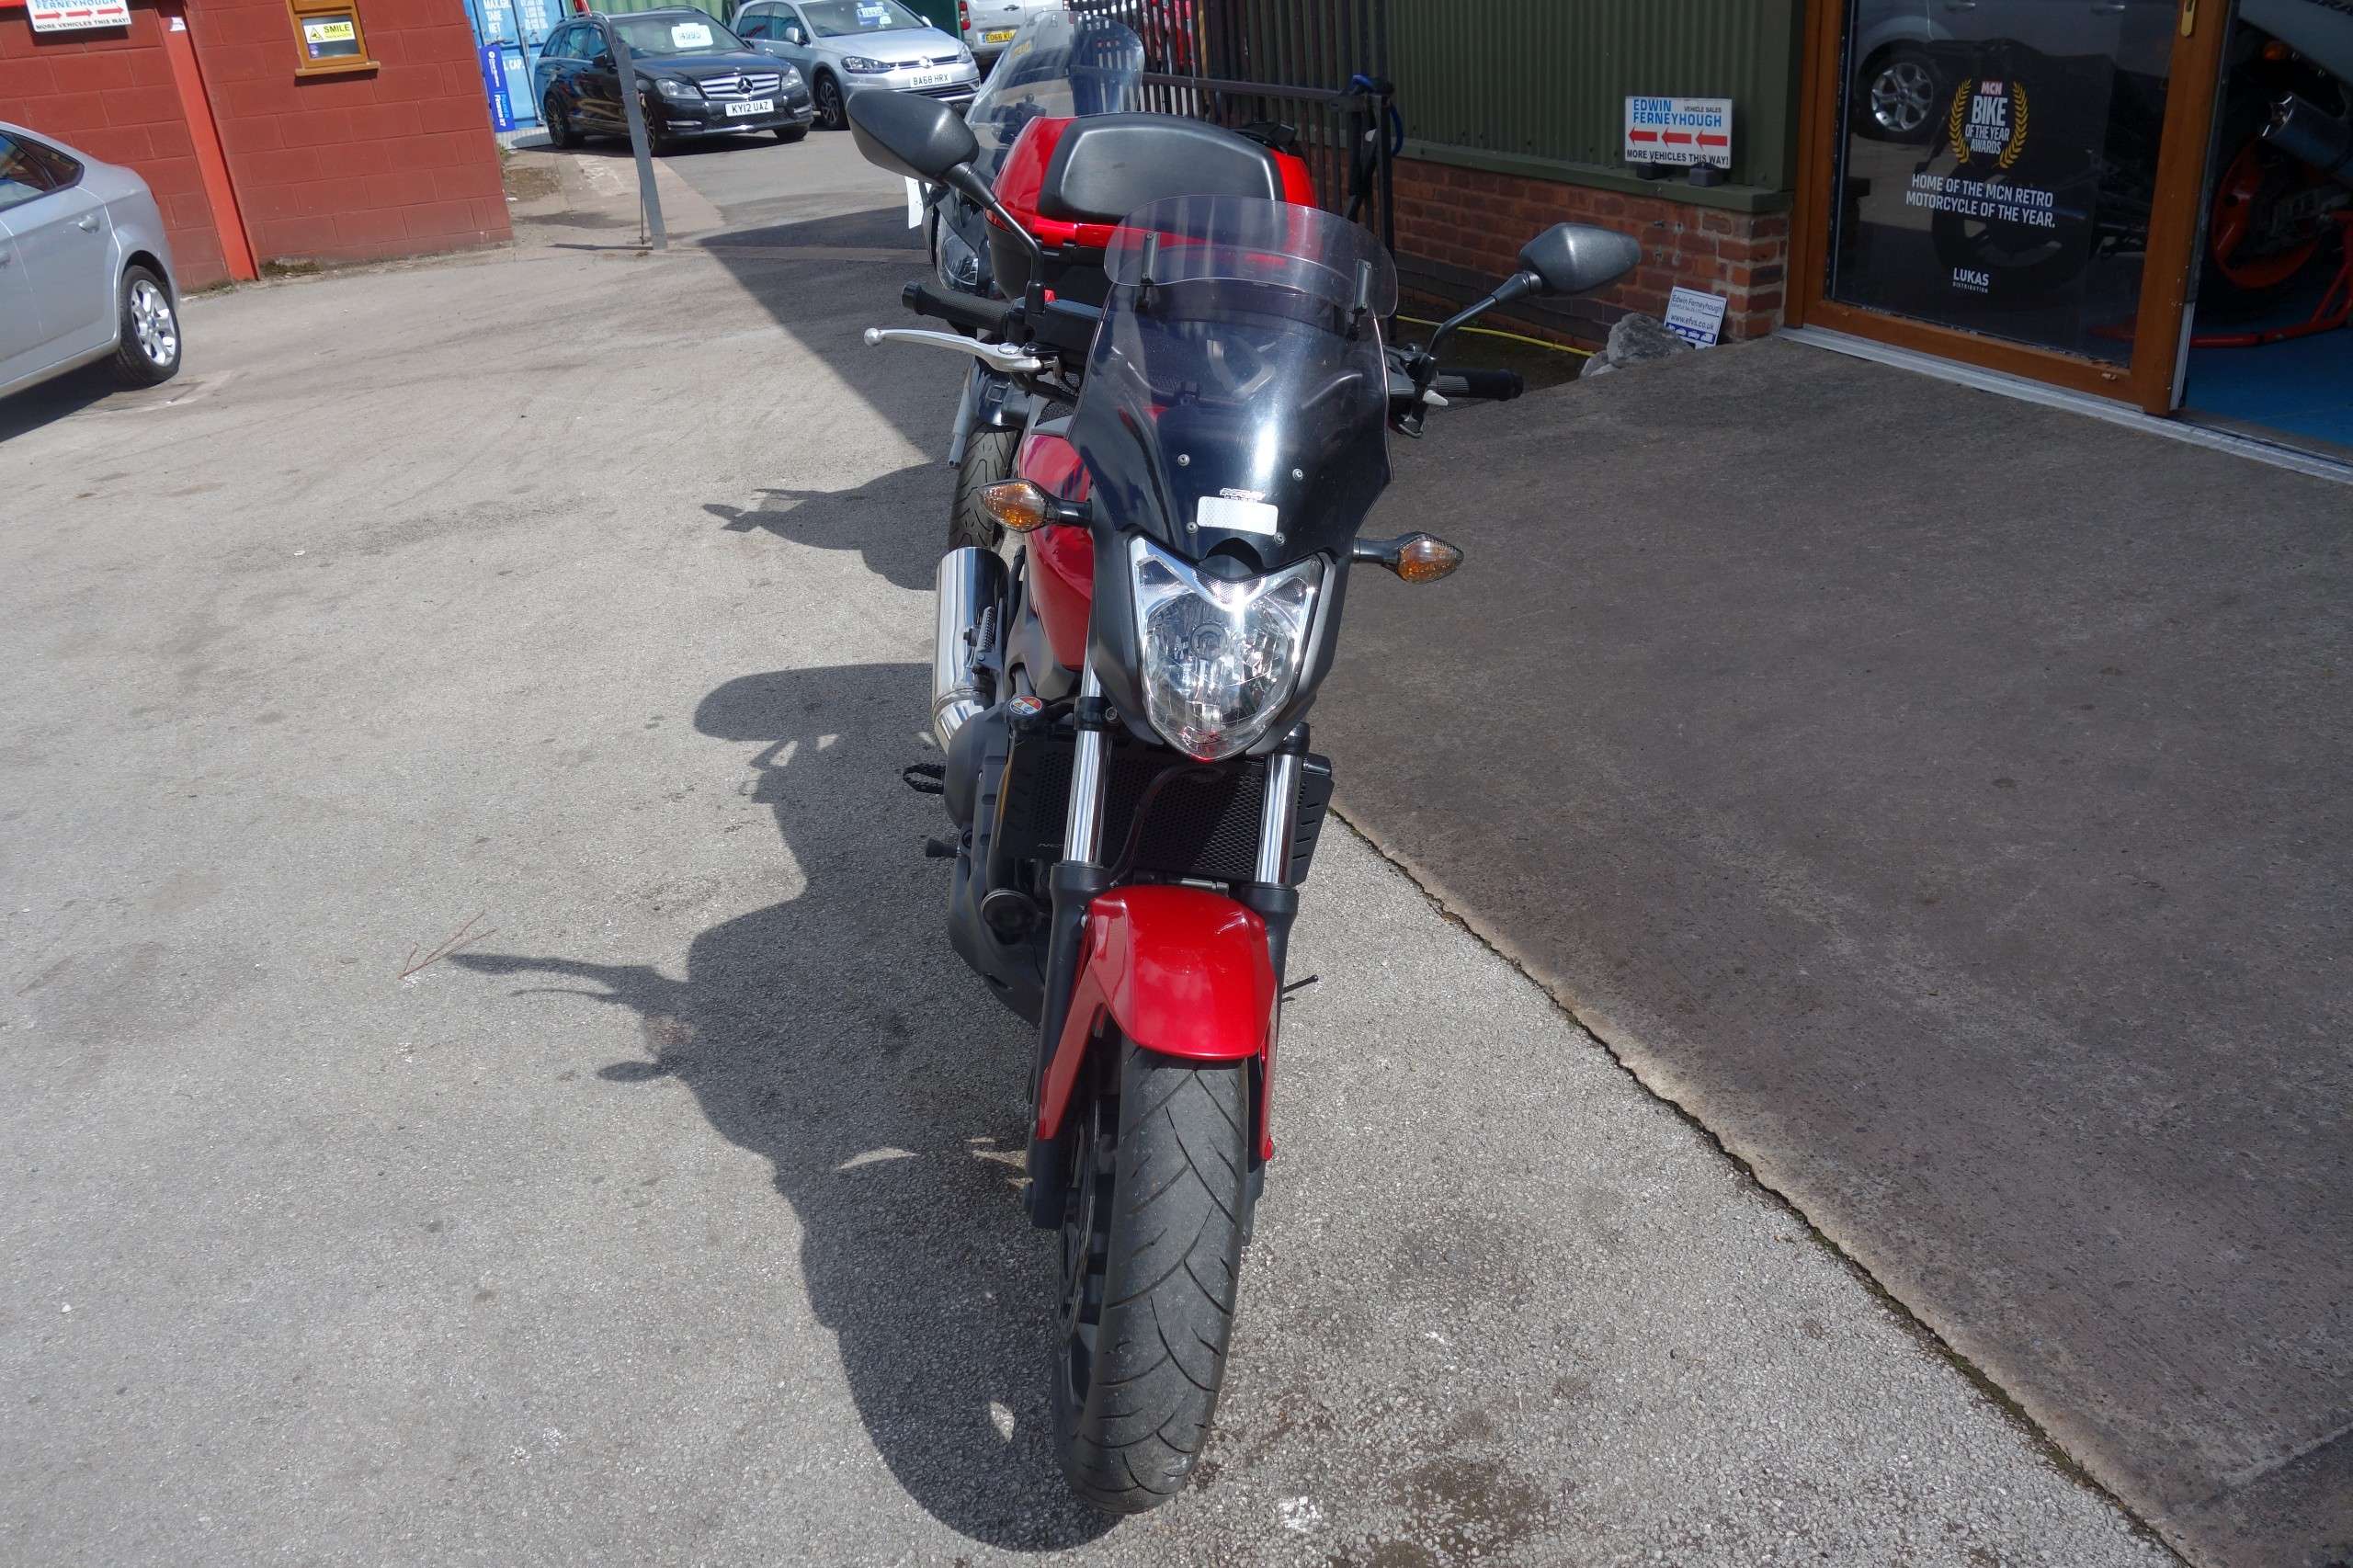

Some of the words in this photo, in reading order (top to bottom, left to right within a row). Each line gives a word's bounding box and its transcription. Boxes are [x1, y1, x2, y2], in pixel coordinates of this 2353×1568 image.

[58, 20, 92, 28] VEHICLES
[324, 24, 350, 33] SMILE
[913, 76, 933, 85] BA68
[934, 74, 949, 84] HRX
[1981, 81, 2003, 95] MCN
[732, 103, 752, 114] KY12
[754, 101, 768, 111] UAZ
[1633, 99, 1672, 112] EDWIN
[1972, 95, 2008, 127] BIKE
[1633, 111, 1722, 127] FERNEYHOUGH
[1965, 124, 1975, 137] OF
[1975, 125, 1989, 140] THE
[1990, 127, 2010, 142] YEAR
[1970, 139, 2002, 154] AWARDS
[1627, 150, 1648, 159] MORE
[1650, 152, 1687, 162] VEHICLES
[1688, 153, 1707, 164] THIS
[1710, 155, 1729, 165] WAY!
[1912, 173, 1943, 191] HOME
[1946, 177, 1960, 193] OF
[1962, 179, 1983, 198] THE
[1985, 183, 2013, 201] MCN
[2015, 187, 2053, 208] RETRO
[1905, 190, 1978, 215] MOTORCYCLE
[1980, 201, 1995, 218] OF
[1997, 204, 2019, 222] THE
[2021, 208, 2056, 229] YEAR.
[1953, 267, 1989, 287] LUKAS
